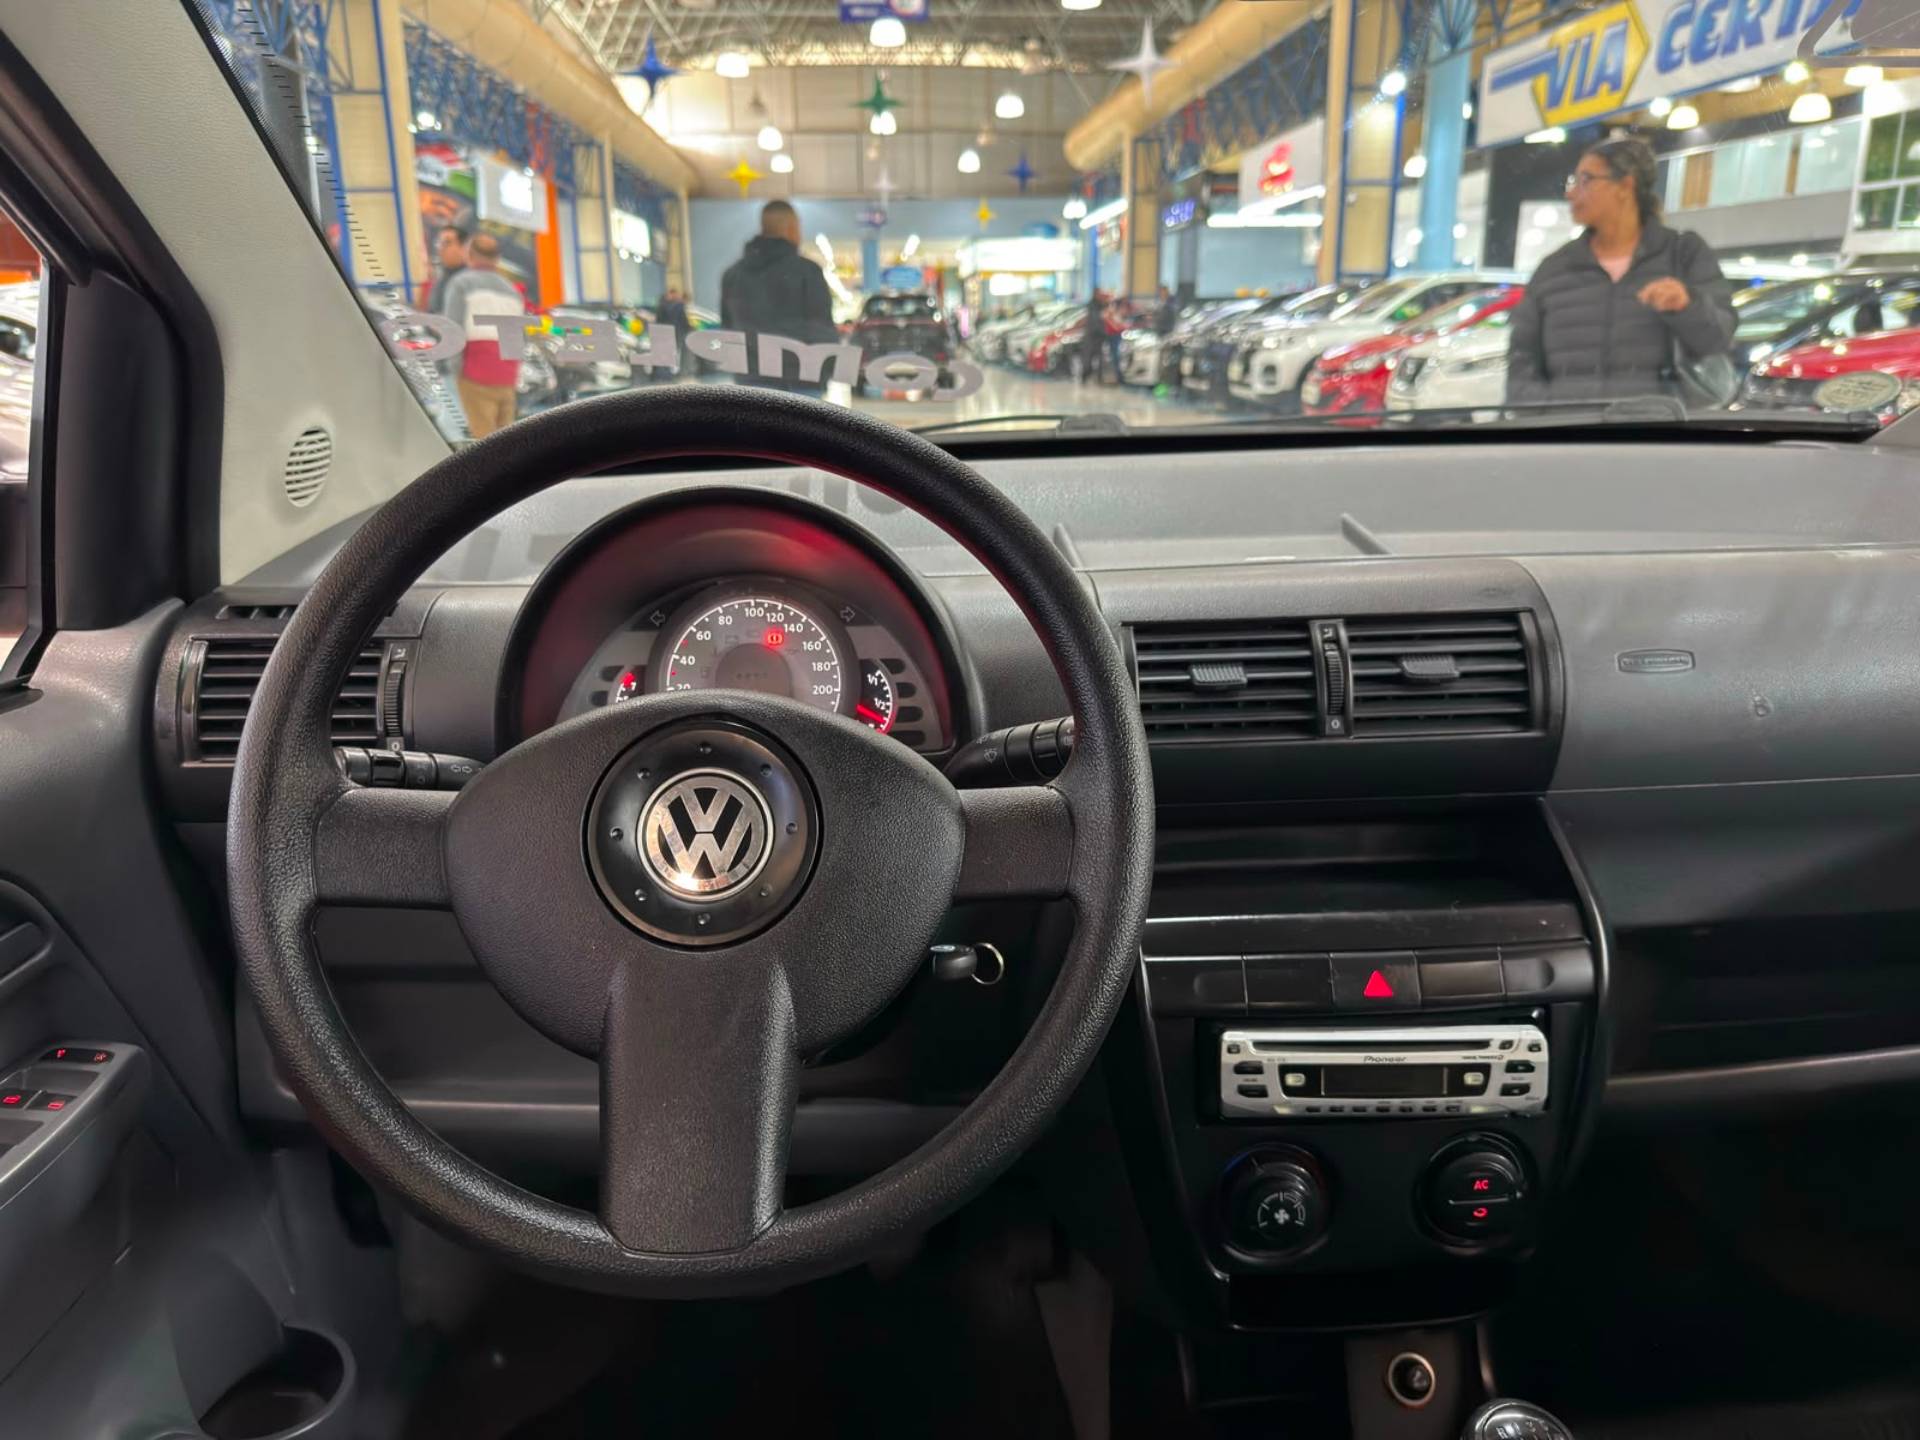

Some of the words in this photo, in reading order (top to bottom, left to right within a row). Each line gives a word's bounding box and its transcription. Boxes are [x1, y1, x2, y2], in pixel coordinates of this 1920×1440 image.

[1545, 19, 1628, 110] VIA
[744, 607, 764, 617] 100
[766, 612, 785, 623] 120
[718, 615, 733, 626] 80
[784, 623, 804, 633] 140
[696, 630, 712, 641] 60
[802, 641, 822, 651] 160
[680, 655, 695, 666] 40
[812, 662, 831, 672] 180
[812, 685, 833, 695] 200
[1473, 1179, 1489, 1191] AC
